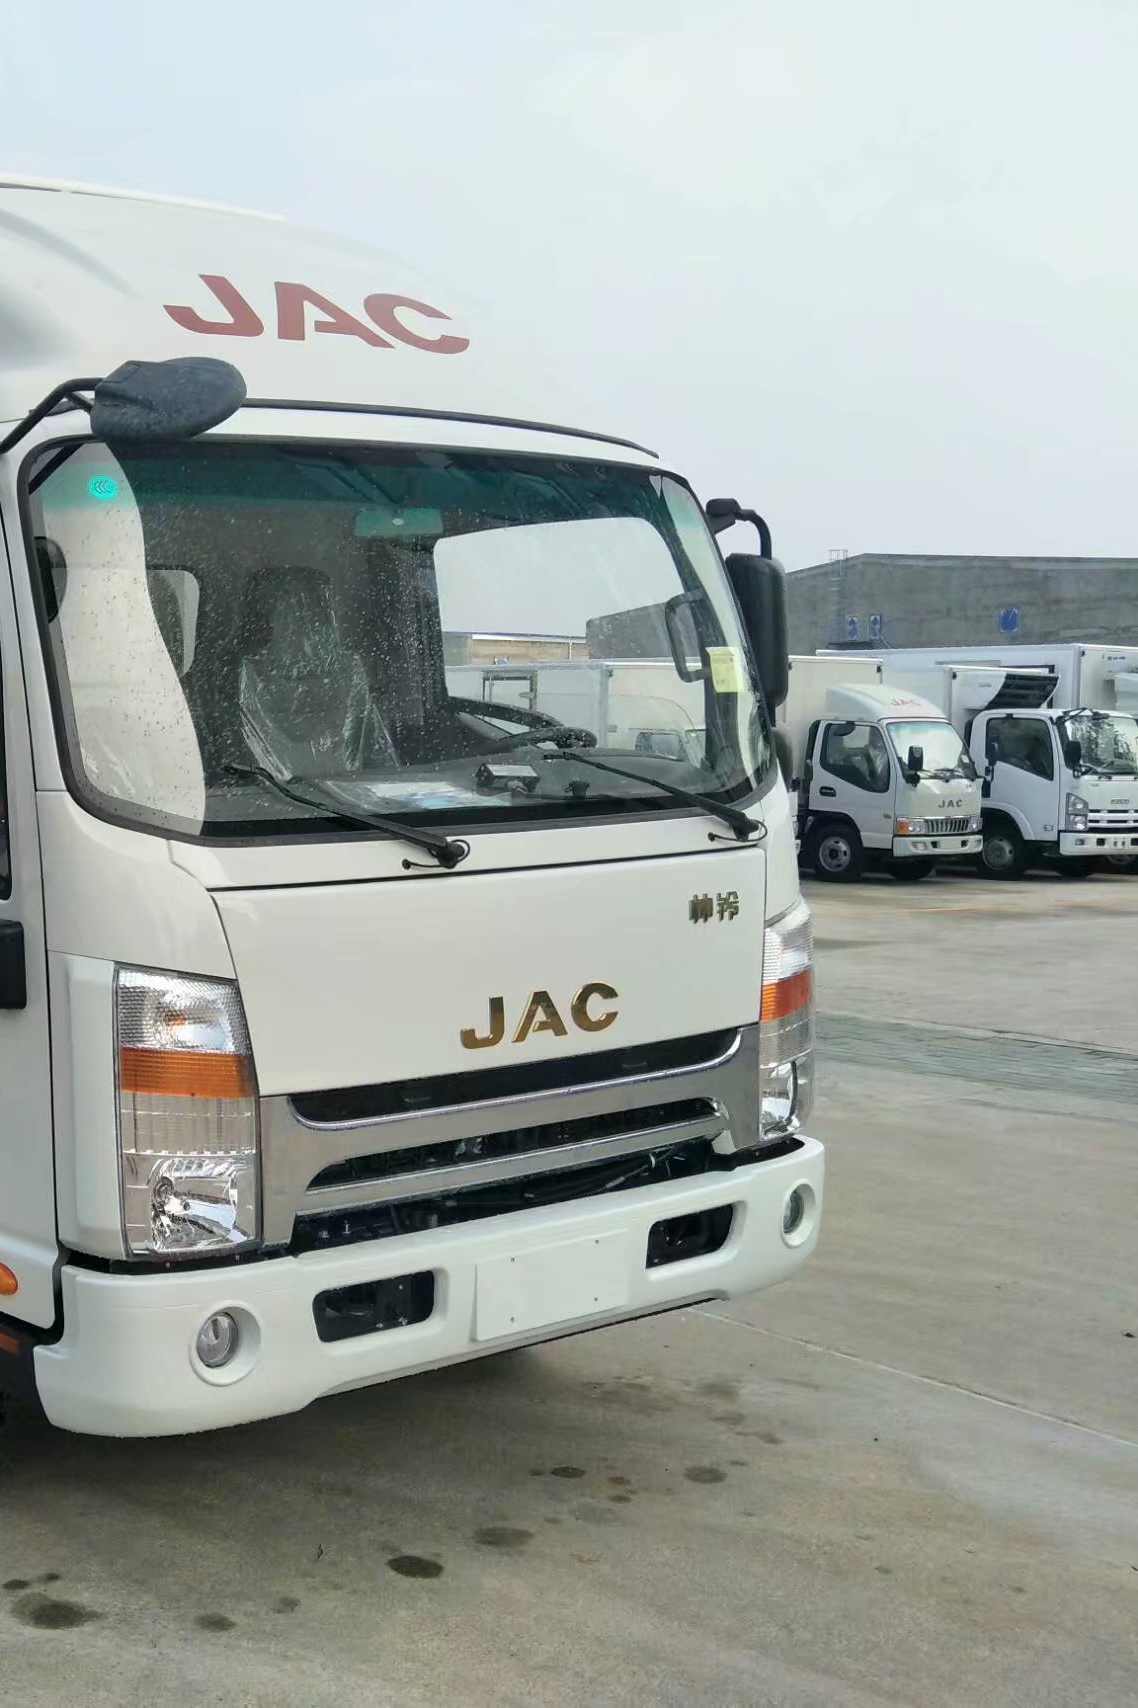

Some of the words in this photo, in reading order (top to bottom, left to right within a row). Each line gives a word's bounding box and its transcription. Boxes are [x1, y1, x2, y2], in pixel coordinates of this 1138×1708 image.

[162, 273, 470, 355] JAC
[938, 799, 963, 809] JAC
[460, 982, 619, 1050] JAC
